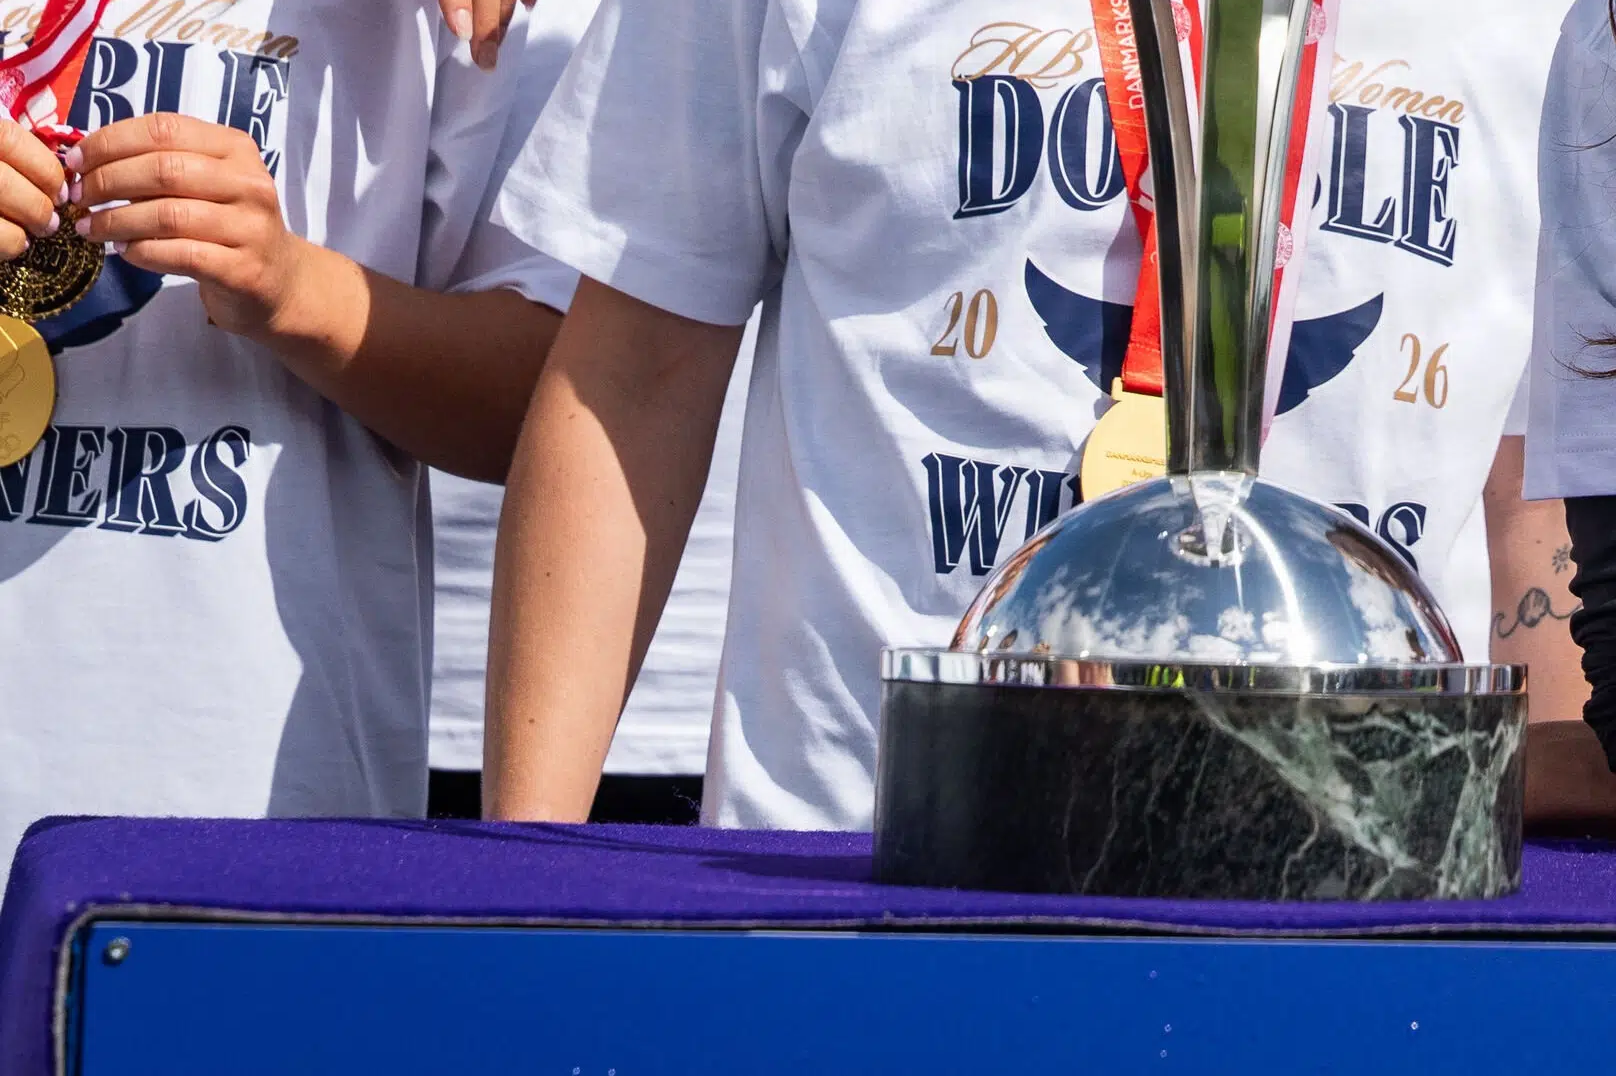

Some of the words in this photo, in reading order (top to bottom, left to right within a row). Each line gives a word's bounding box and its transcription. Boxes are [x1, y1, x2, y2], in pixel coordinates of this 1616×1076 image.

[953, 74, 1460, 268] DOLE
[930, 288, 999, 360] 20
[1394, 332, 1449, 410] 26
